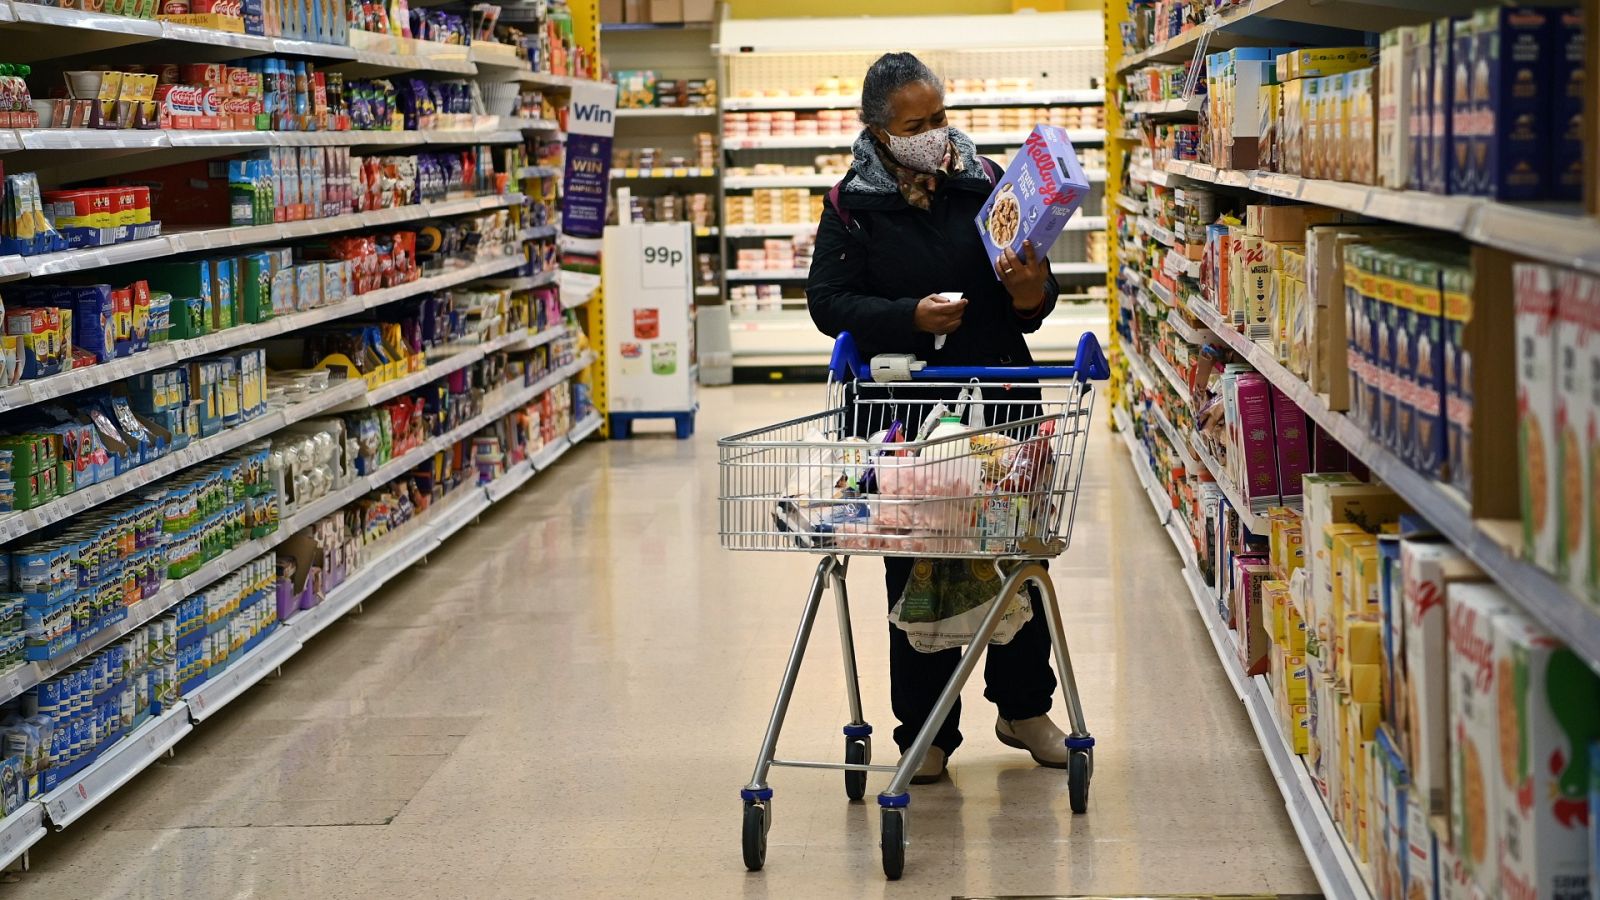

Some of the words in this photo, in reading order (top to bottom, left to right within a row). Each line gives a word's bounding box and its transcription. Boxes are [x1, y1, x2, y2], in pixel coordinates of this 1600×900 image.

[573, 102, 612, 123] Win
[572, 159, 603, 173] WIN
[1025, 131, 1077, 206] Kellogg's
[644, 246, 683, 267] 99p
